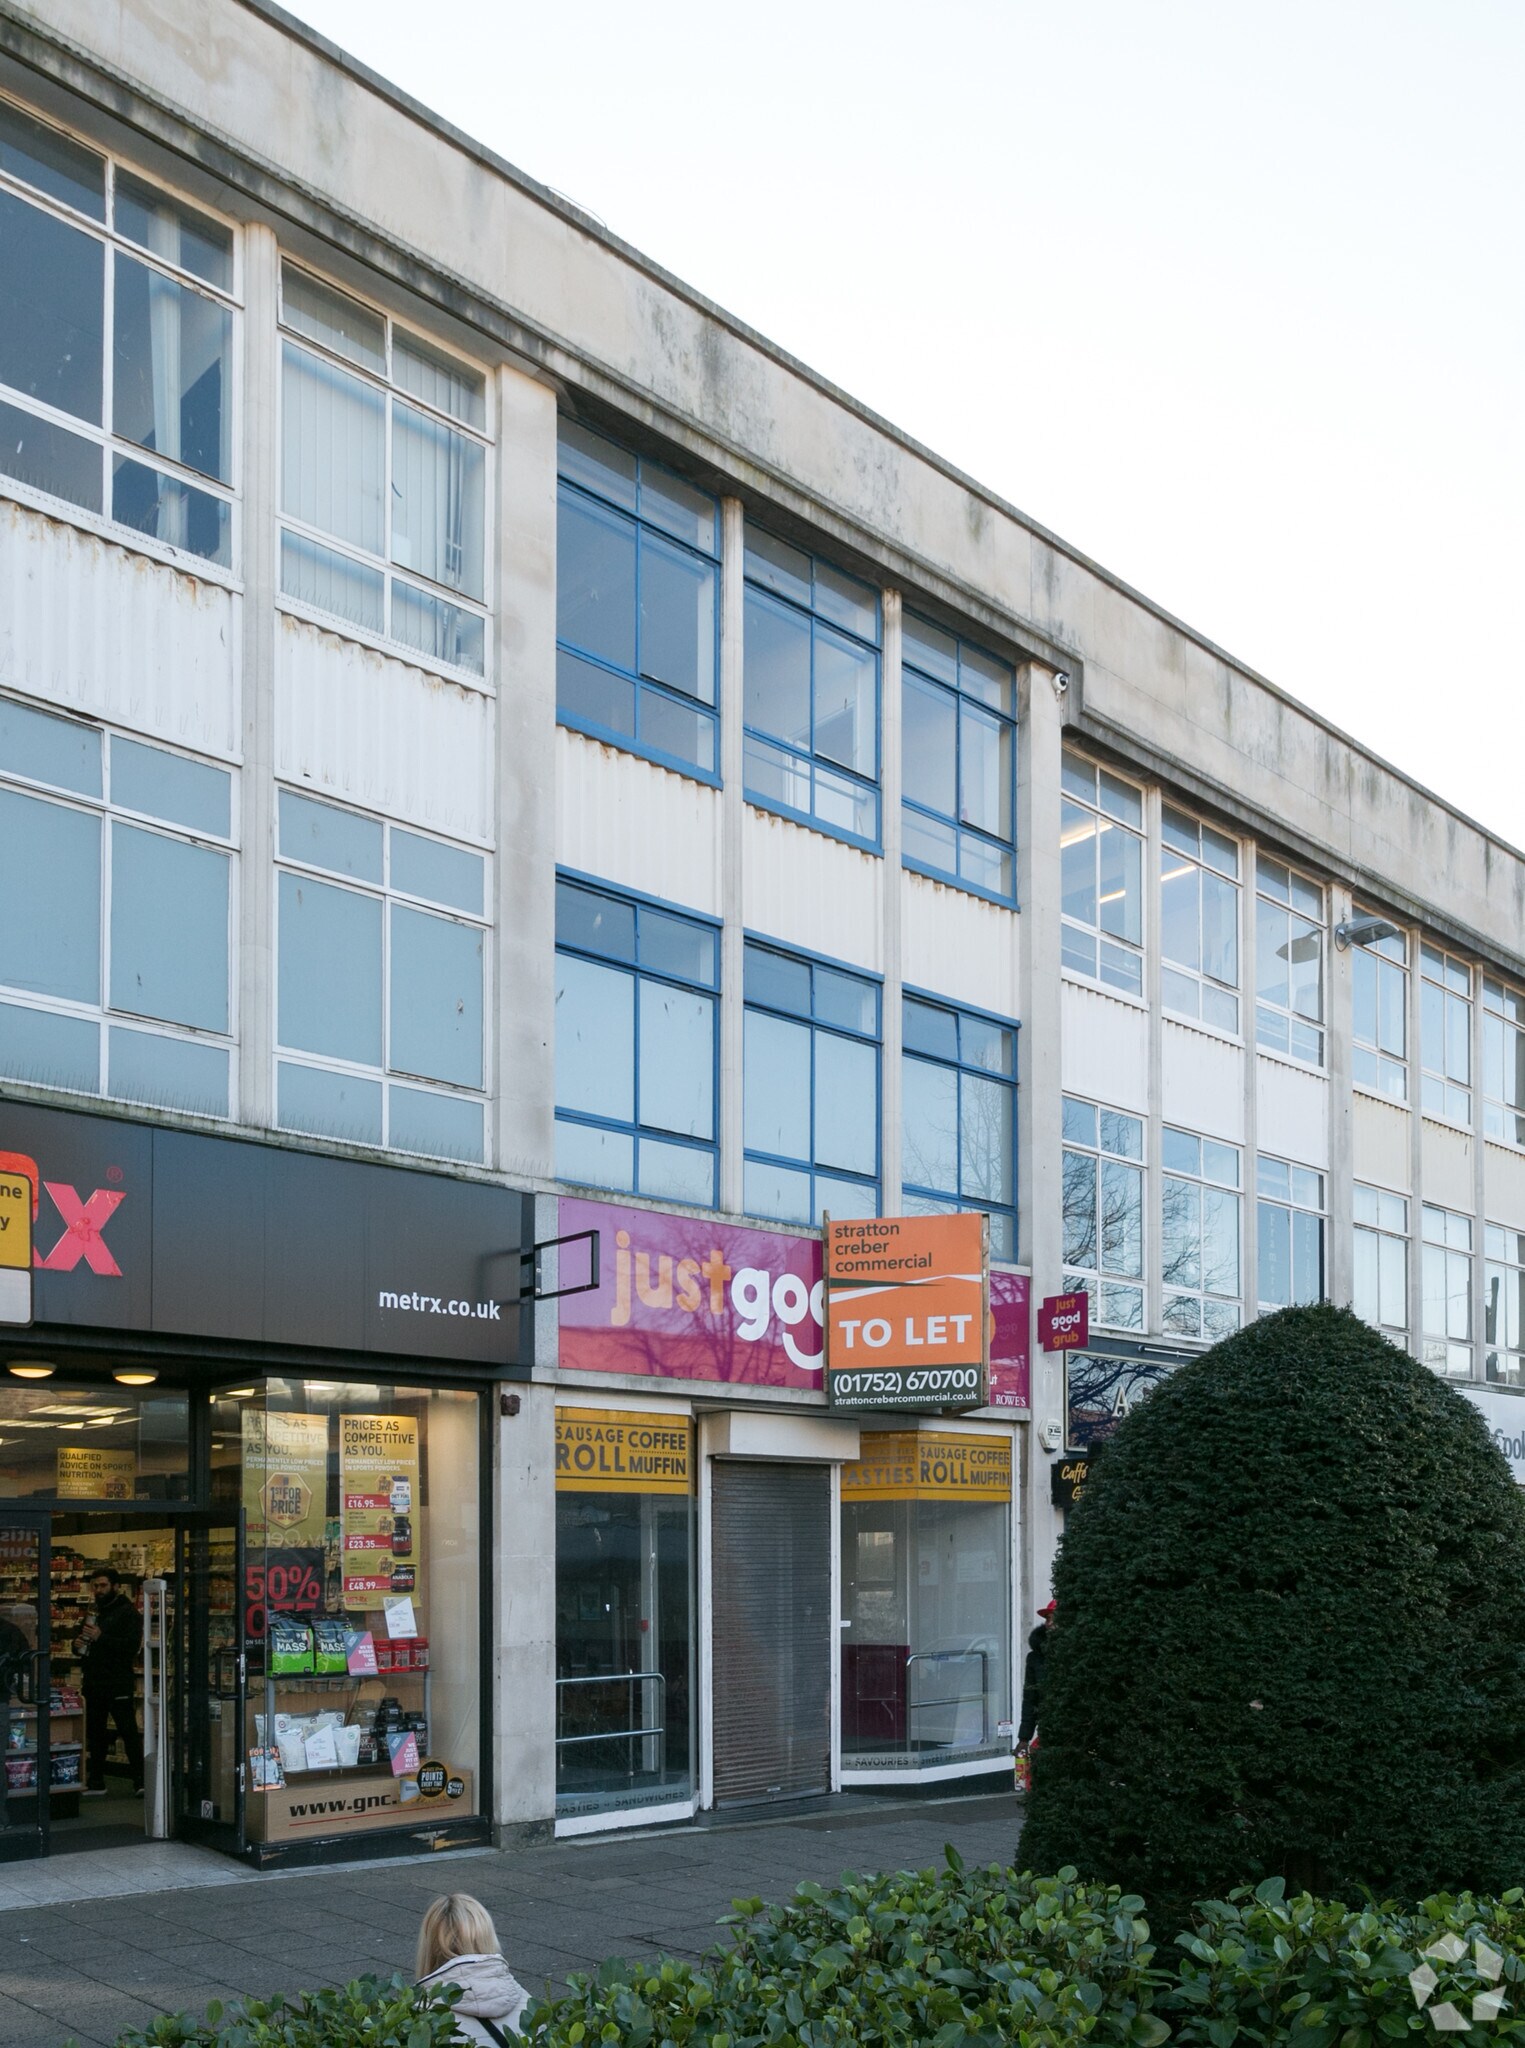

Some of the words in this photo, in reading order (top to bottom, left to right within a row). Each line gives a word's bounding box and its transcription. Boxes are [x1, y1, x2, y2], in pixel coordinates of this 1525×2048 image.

[835, 1223, 900, 1239] stratton
[835, 1239, 890, 1256] creber
[835, 1252, 932, 1273] commercial
[379, 1291, 501, 1320] metrx.co.uk
[1055, 1297, 1077, 1314] just
[1051, 1311, 1081, 1330] good
[838, 1318, 893, 1349] TO
[905, 1314, 973, 1346] LET
[1053, 1331, 1079, 1348] grub
[834, 1371, 902, 1396] (01752)
[906, 1368, 978, 1391] 670700
[834, 1391, 978, 1406] strattoncrebercommercial.co.uk
[995, 1394, 1026, 1407] ROWE'S
[344, 1419, 383, 1431] PRICES
[385, 1420, 400, 1432] AS
[344, 1432, 415, 1445] COMPETITIVE
[555, 1426, 624, 1444] SAUSAGE
[628, 1430, 687, 1451] COFFEE
[60, 1452, 102, 1461] QUALIFIED
[246, 1442, 263, 1454] AS
[266, 1444, 293, 1456] YOU.
[345, 1444, 359, 1456] AS
[361, 1445, 386, 1457] YOU.
[920, 1446, 967, 1461] SAUSAGE
[555, 1443, 626, 1473] ROLL
[969, 1449, 1010, 1466] COFFEE
[60, 1461, 88, 1470] ADVICE
[89, 1462, 101, 1470] ON
[102, 1463, 134, 1472] SPORTS
[629, 1456, 687, 1476] MUFFIN
[920, 1461, 969, 1485] ROLL
[969, 1470, 1011, 1487] MUFFIN
[283, 1487, 302, 1501] FOR
[270, 1500, 301, 1514] PRICE
[348, 1499, 375, 1508] £16.95
[348, 1540, 376, 1549] £23.35
[245, 1565, 321, 1601] 50%
[348, 1581, 376, 1591] £48.99
[276, 1642, 307, 1652] MASS
[320, 1642, 346, 1652] MASS
[854, 1756, 909, 1767] SAVOURIES
[421, 1771, 444, 1781] POINTS
[289, 1794, 397, 1817] www.gnc.
[614, 1791, 685, 1807] SANDWICHES
